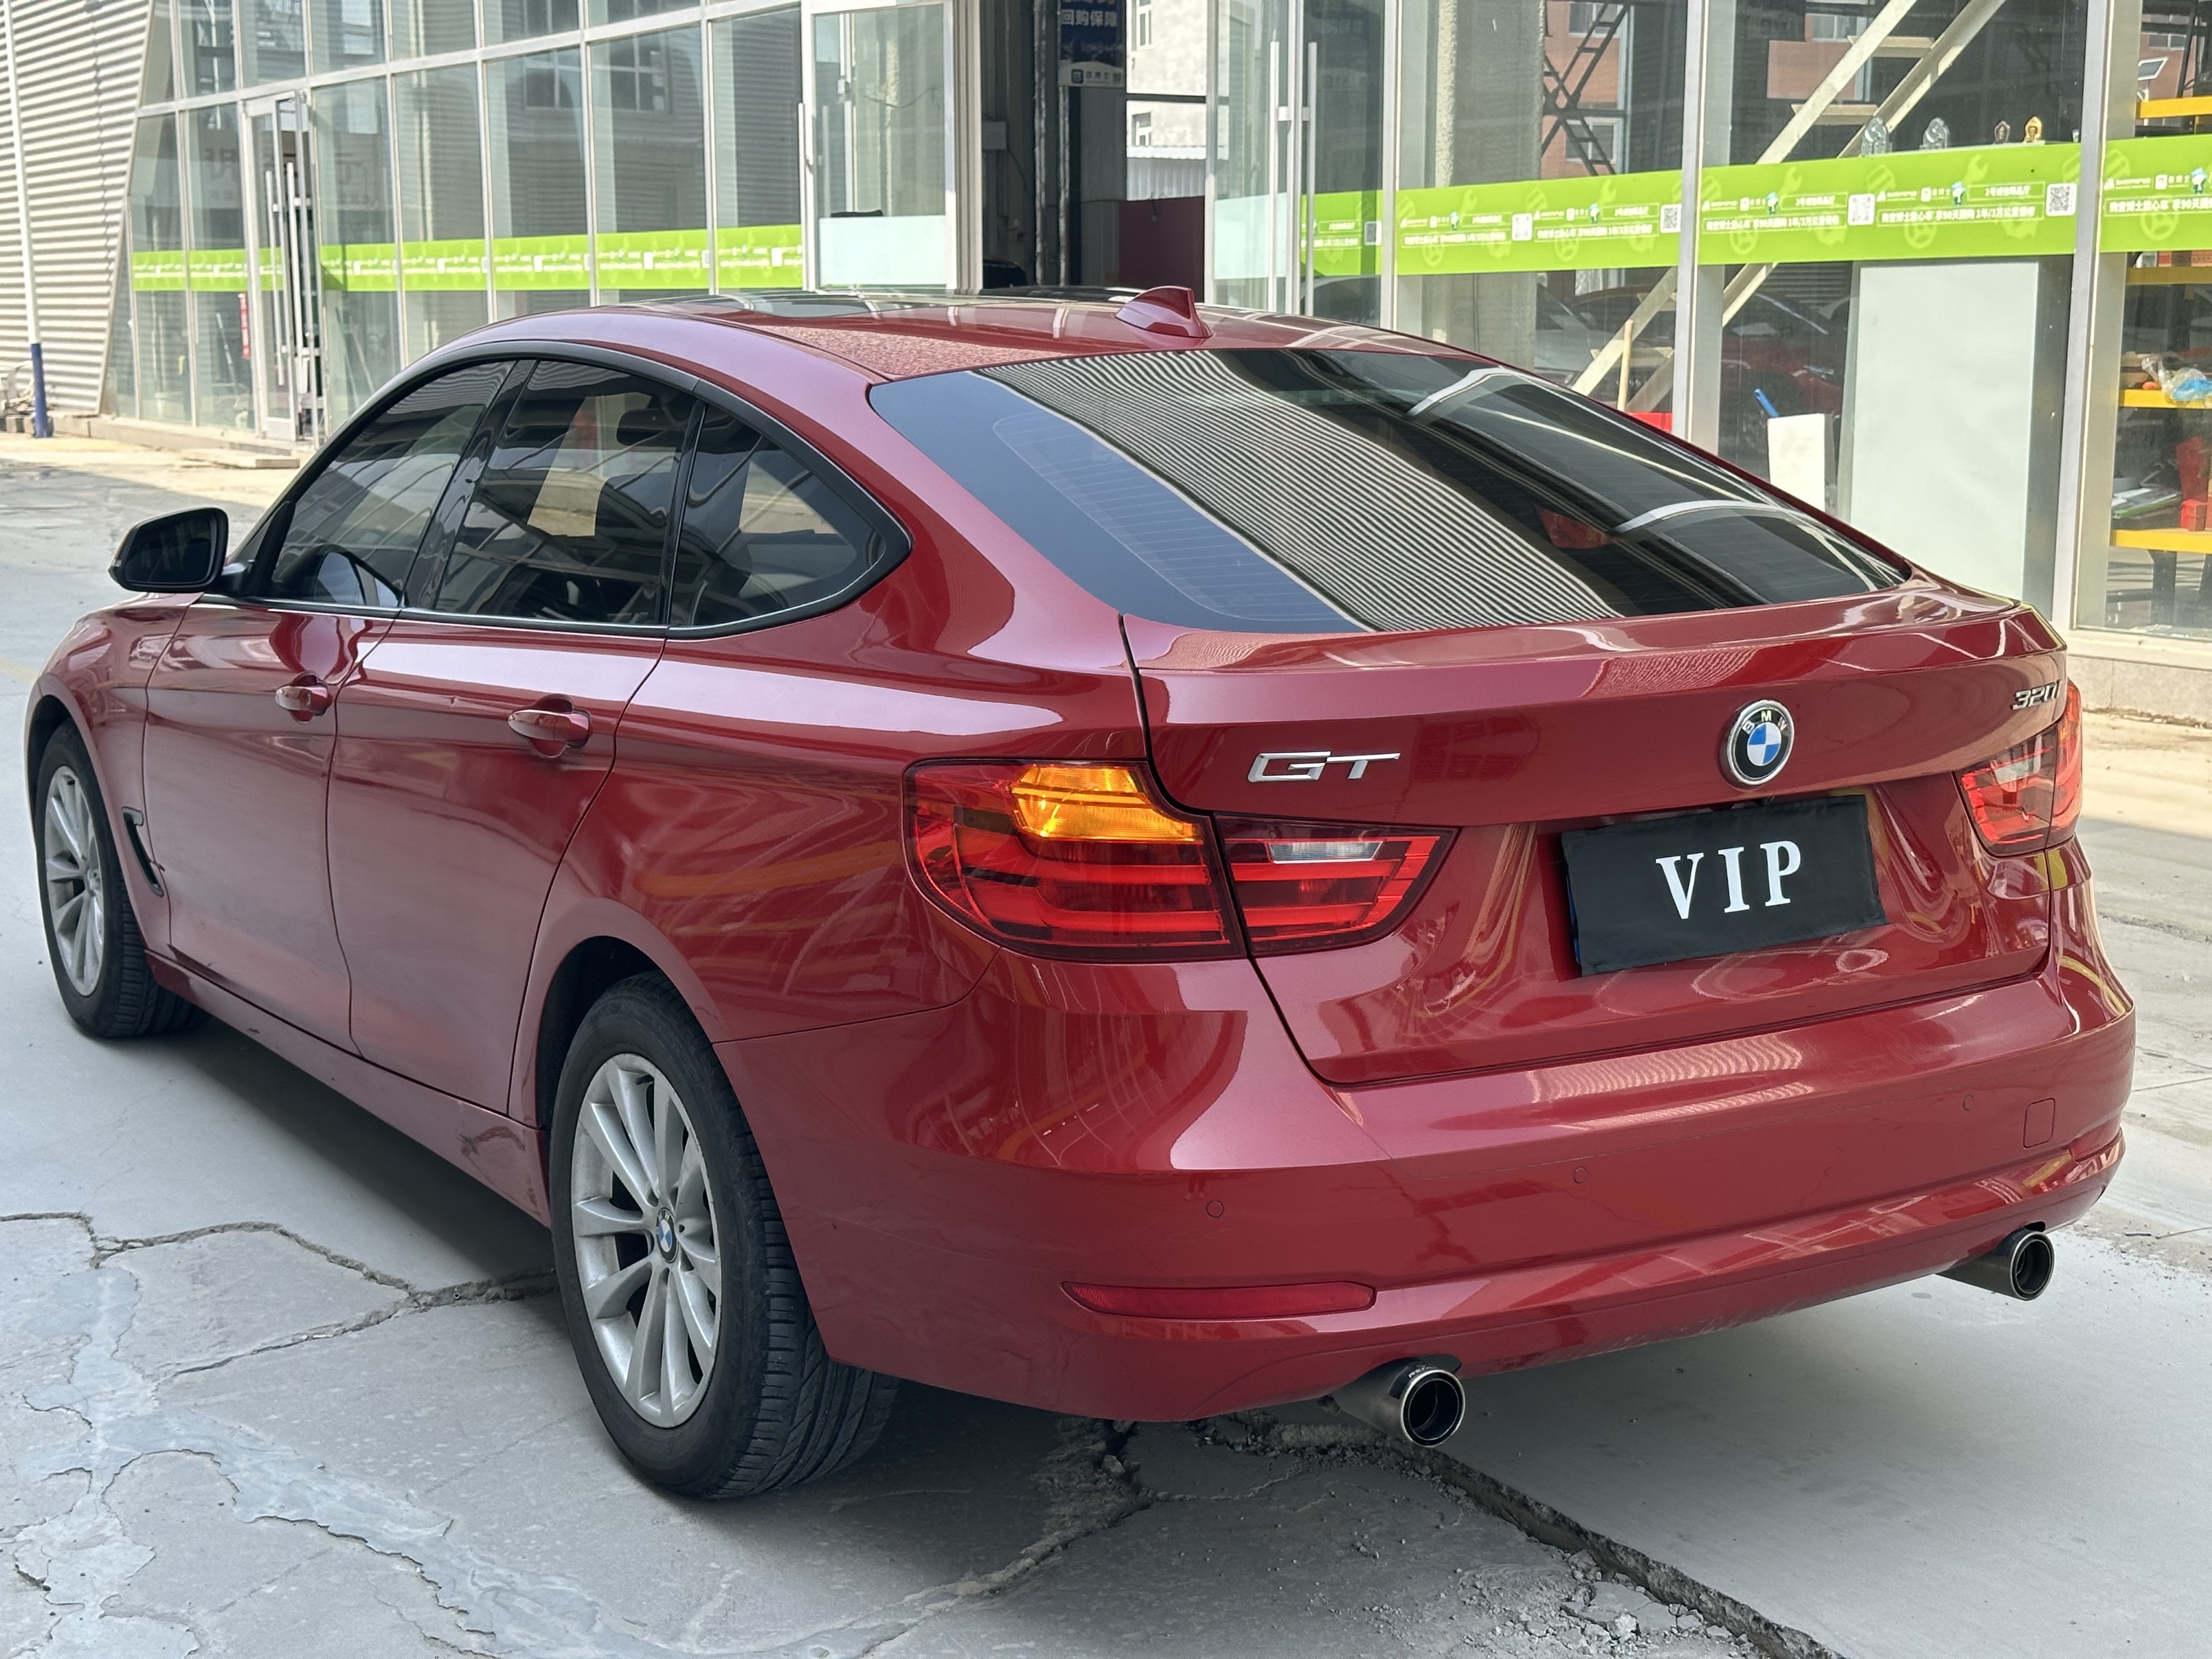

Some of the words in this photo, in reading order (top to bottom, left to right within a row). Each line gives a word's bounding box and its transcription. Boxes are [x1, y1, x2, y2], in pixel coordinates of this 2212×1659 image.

[1742, 710, 1787, 735] BMW
[1248, 751, 1401, 783] GT
[1655, 840, 1801, 919] VIP
